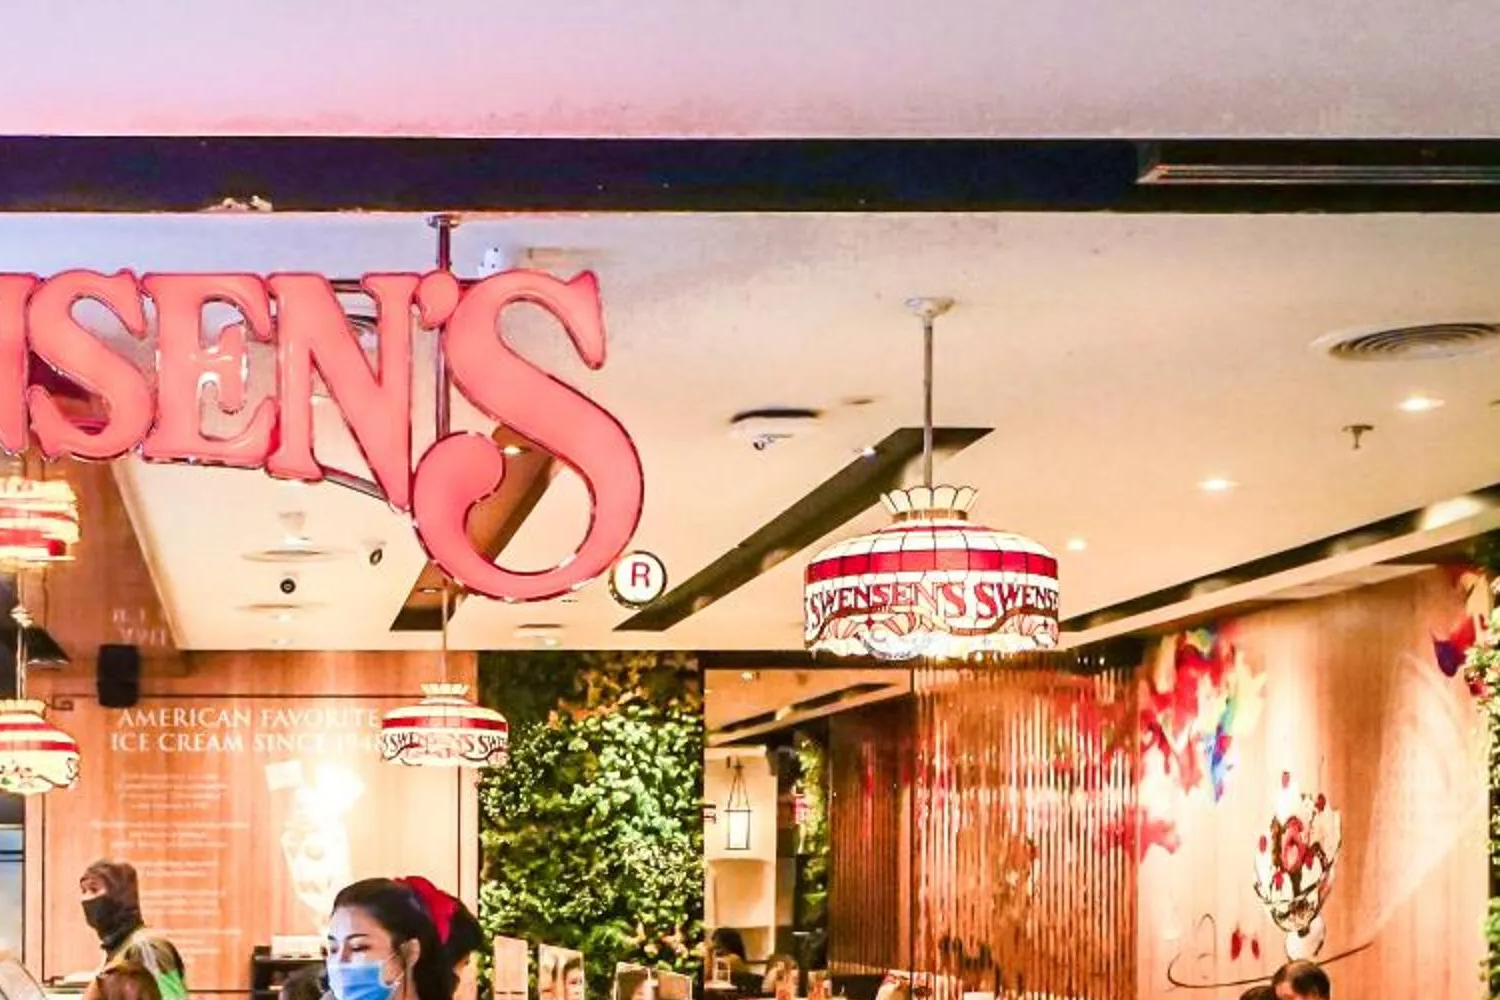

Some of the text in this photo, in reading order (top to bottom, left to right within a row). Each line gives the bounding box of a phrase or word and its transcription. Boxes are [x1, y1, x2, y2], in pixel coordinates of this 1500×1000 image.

[117, 706, 381, 729] AMERICAN FAVORITE
[111, 732, 151, 752] ICE
[157, 732, 245, 753] CREAM
[254, 732, 329, 754] SINCE
